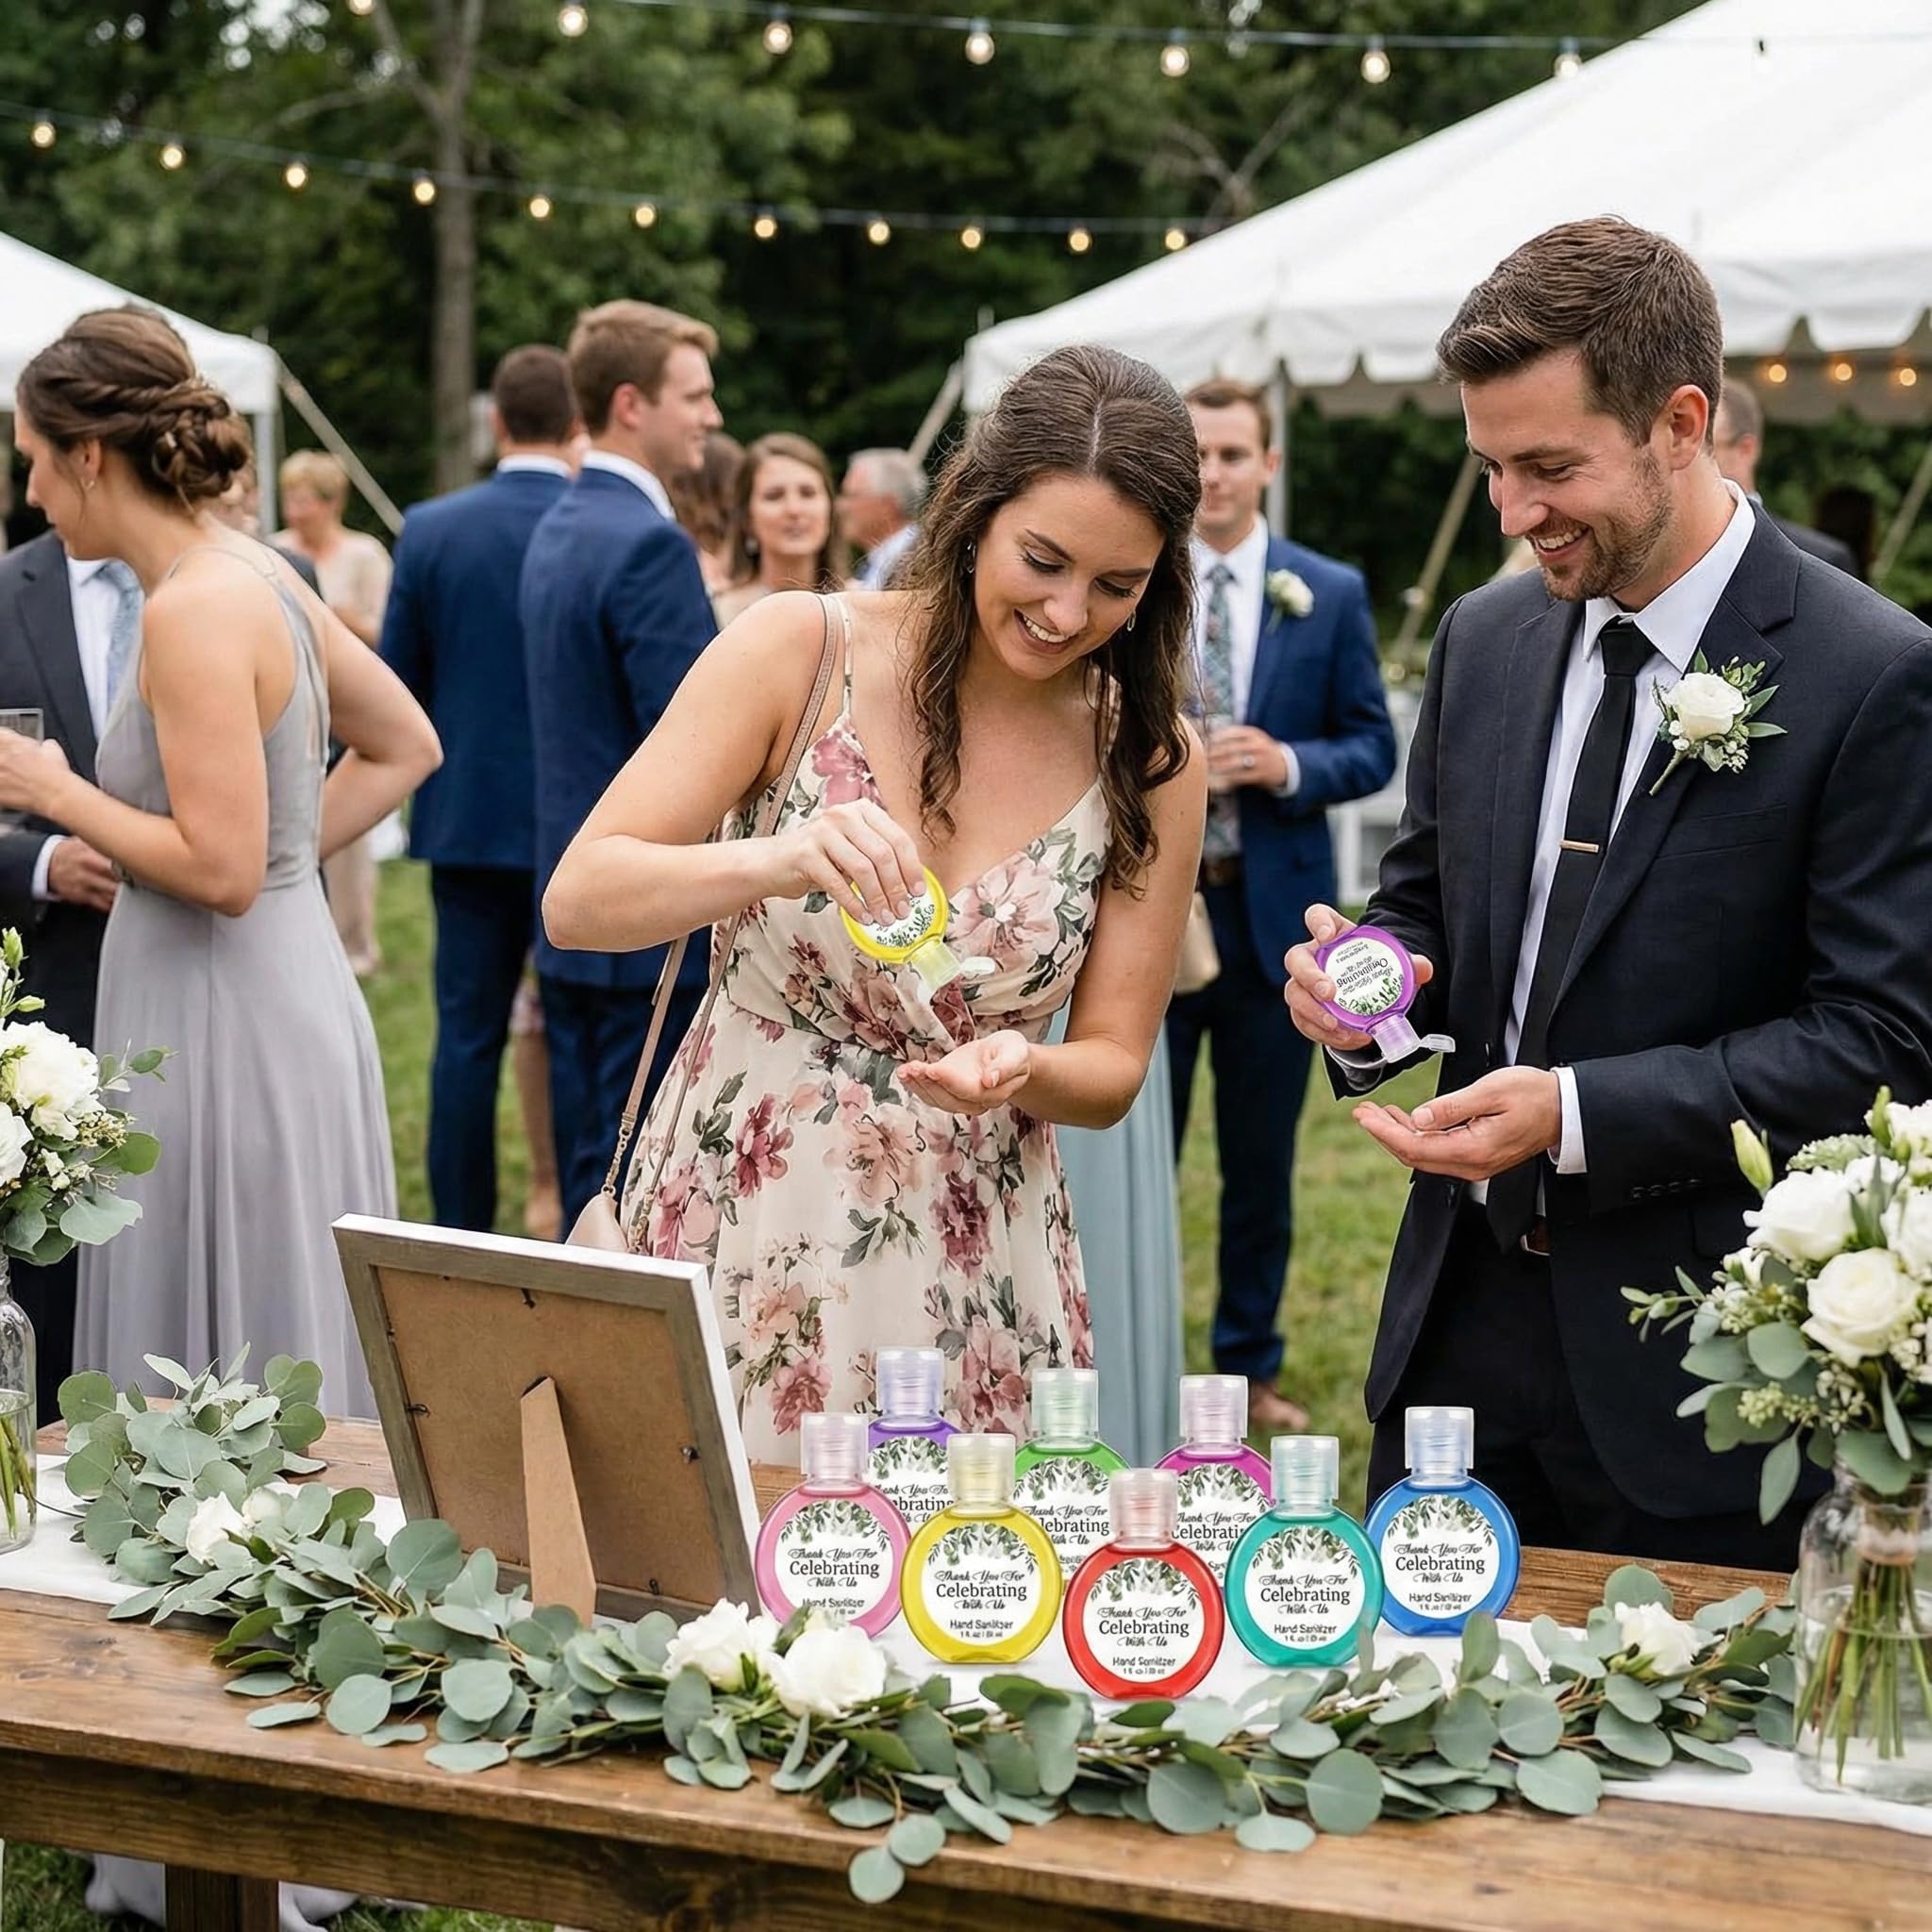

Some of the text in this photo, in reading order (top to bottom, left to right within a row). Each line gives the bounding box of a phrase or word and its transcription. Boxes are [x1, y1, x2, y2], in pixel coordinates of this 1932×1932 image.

[1039, 1517, 1109, 1537] lebrating
[790, 1559, 880, 1578] Celebrating
[1395, 1555, 1486, 1574] Celebrating
[936, 1582, 1027, 1601] Celebrating
[1260, 1587, 1351, 1606] Celebrating
[1099, 1619, 1190, 1638] Celebrating
